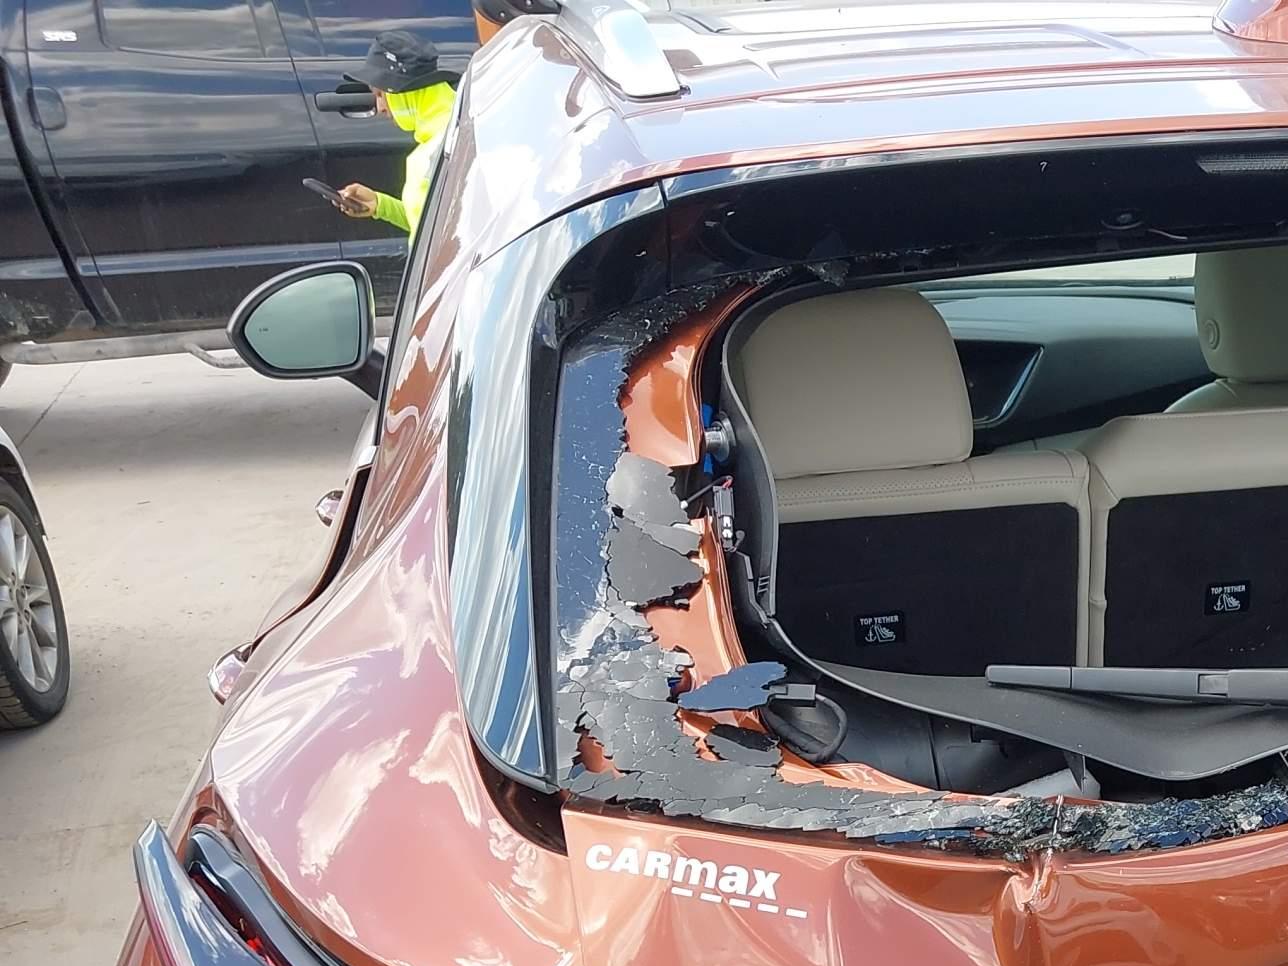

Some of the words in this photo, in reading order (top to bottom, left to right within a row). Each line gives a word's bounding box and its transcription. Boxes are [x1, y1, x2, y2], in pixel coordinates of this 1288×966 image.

[1210, 586, 1223, 595] TOP
[1223, 584, 1246, 593] TETHER
[859, 617, 872, 626] TOP
[873, 614, 899, 624] TETHER
